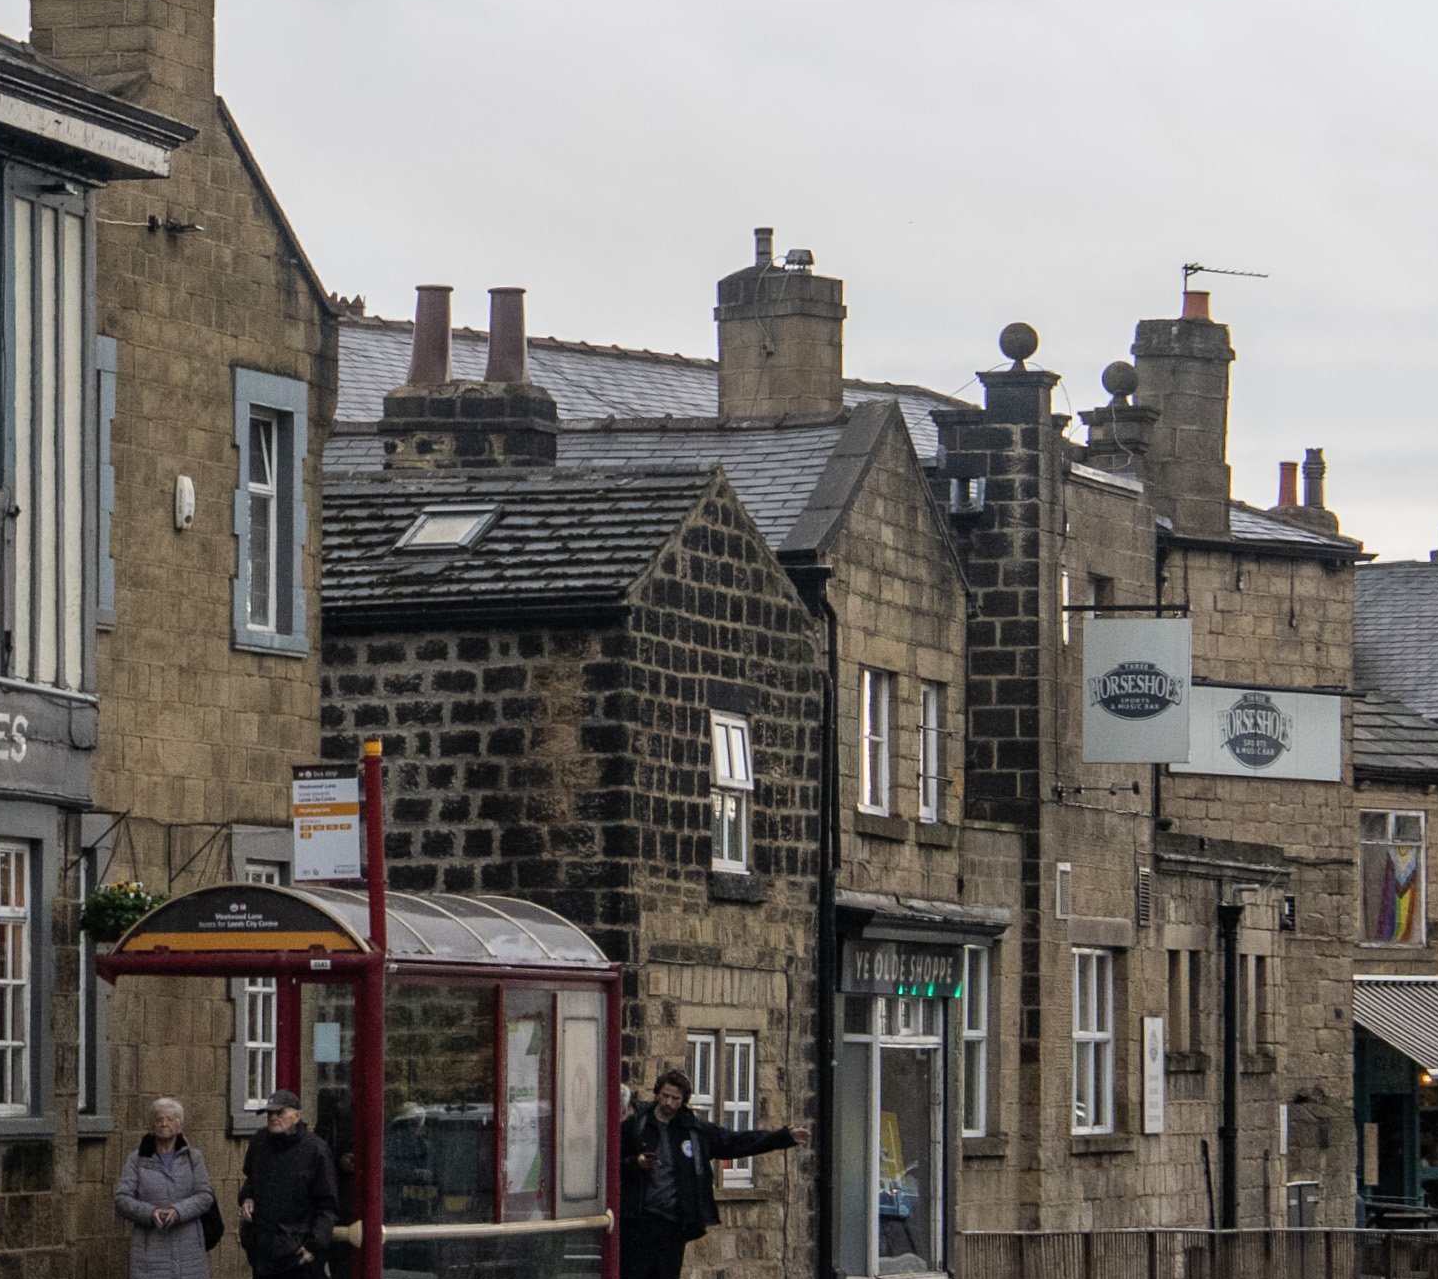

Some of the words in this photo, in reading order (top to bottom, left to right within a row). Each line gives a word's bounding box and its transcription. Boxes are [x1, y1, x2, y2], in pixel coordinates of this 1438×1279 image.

[1088, 675, 1182, 705] HORSESHOES
[855, 951, 870, 980] YE
[874, 952, 906, 981] OLDE
[909, 954, 953, 984] SHOPPE
